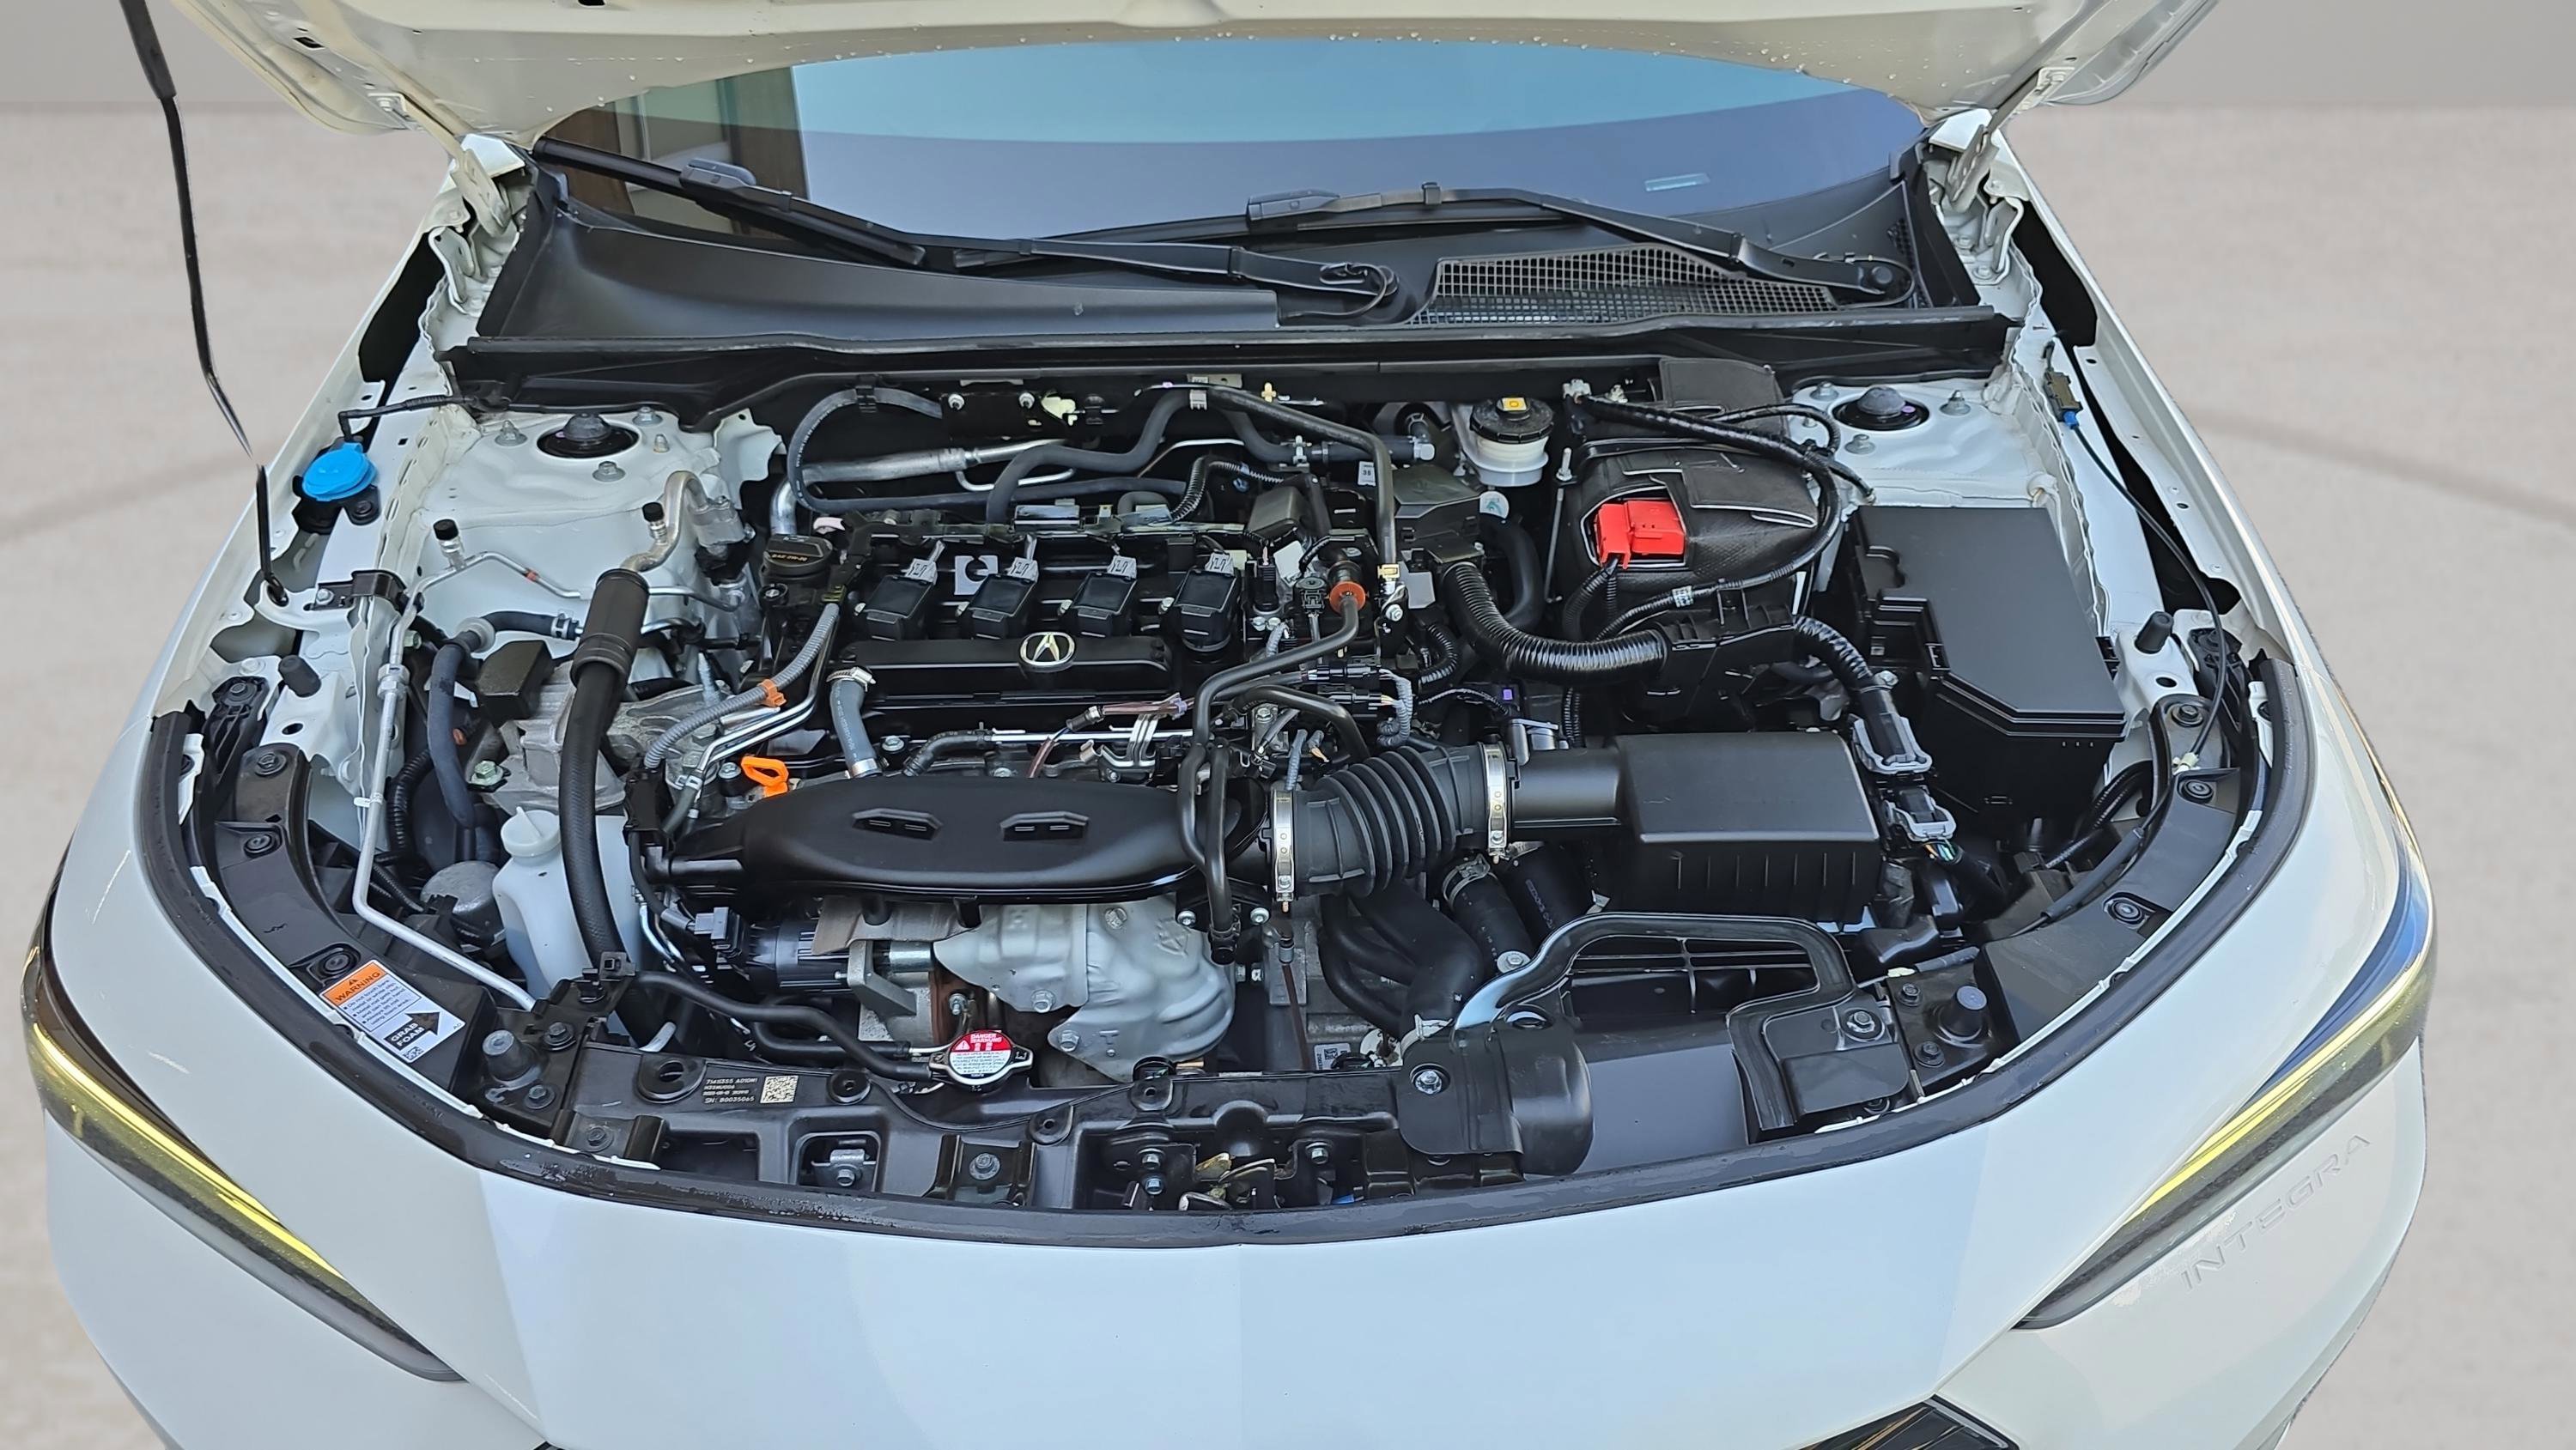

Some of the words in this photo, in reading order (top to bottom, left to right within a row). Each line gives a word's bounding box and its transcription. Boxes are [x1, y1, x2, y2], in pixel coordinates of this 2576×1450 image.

[335, 972, 381, 1002] WARNING
[390, 1022, 419, 1042] GRAB
[396, 1026, 425, 1047] FOAM
[2182, 1135, 2370, 1289] INTEGRA
